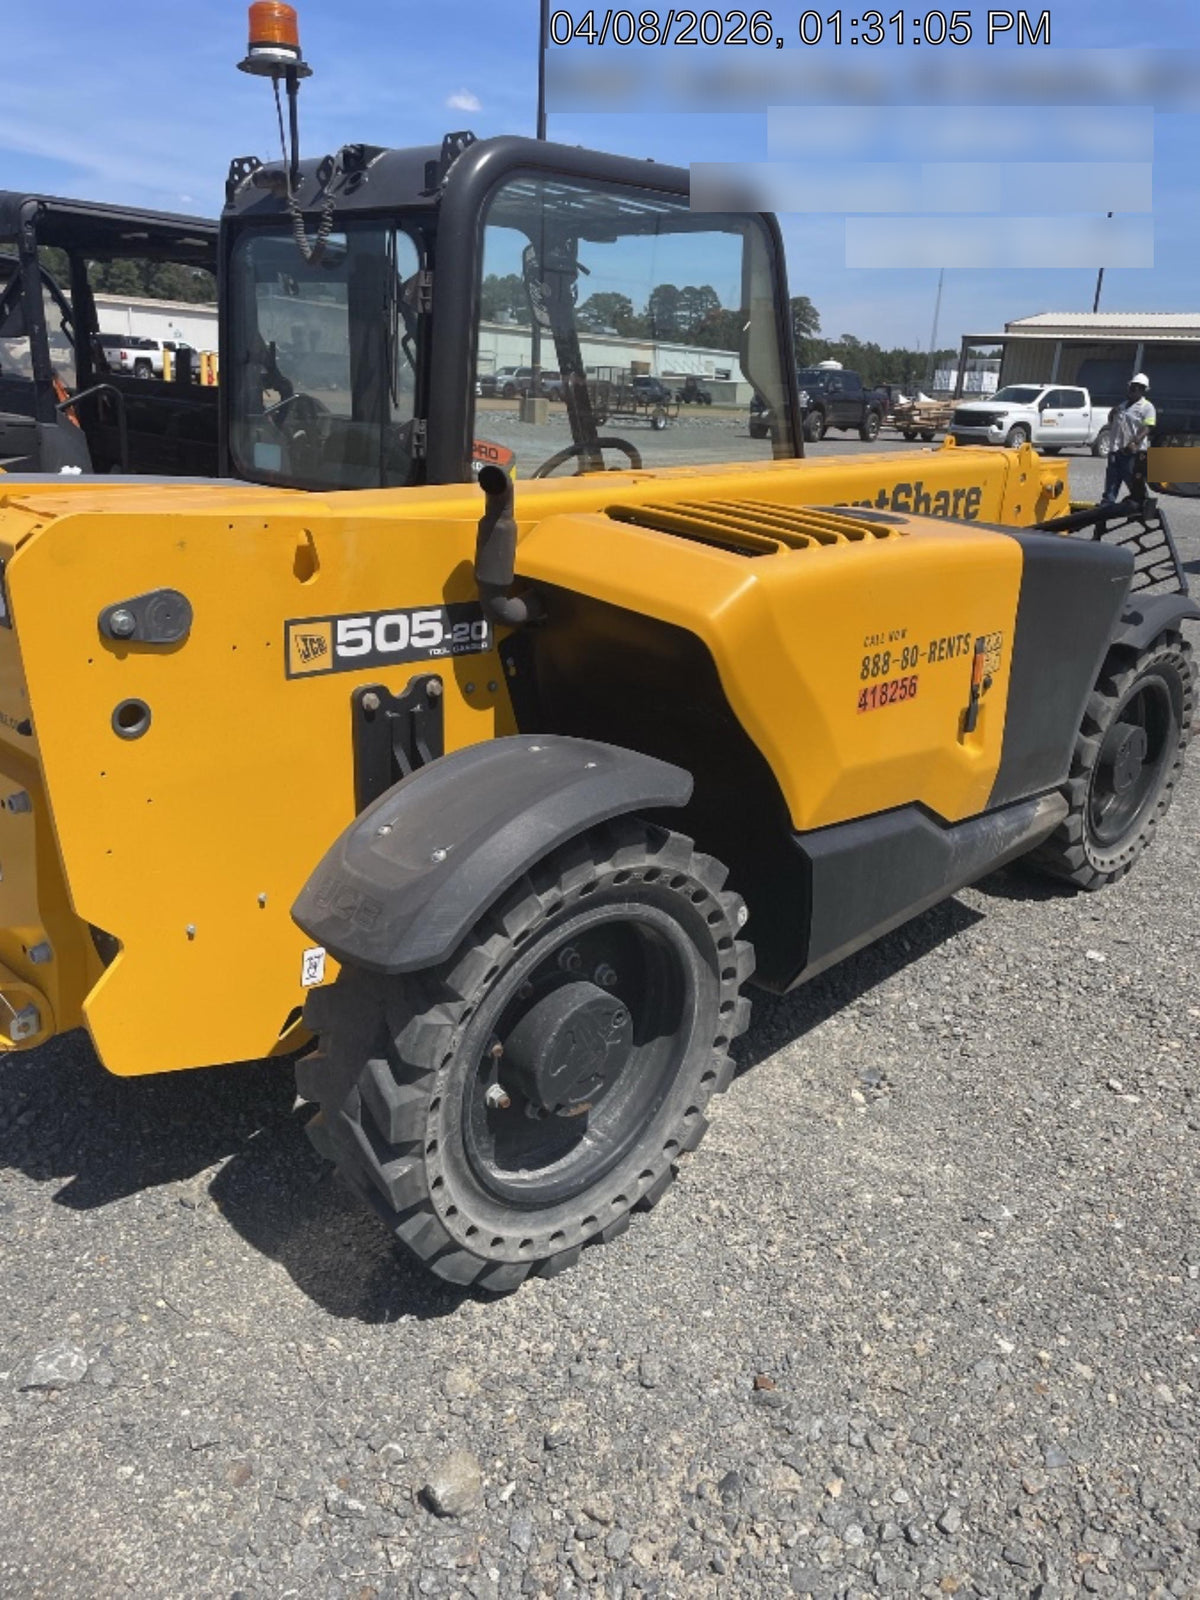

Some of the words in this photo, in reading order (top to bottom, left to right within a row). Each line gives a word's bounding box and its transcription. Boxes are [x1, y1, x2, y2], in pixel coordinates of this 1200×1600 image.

[335, 608, 488, 658] 505-20
[863, 632, 885, 648] CALL
[860, 632, 972, 681] 888-80-RENTS
[857, 674, 919, 712] 418256
